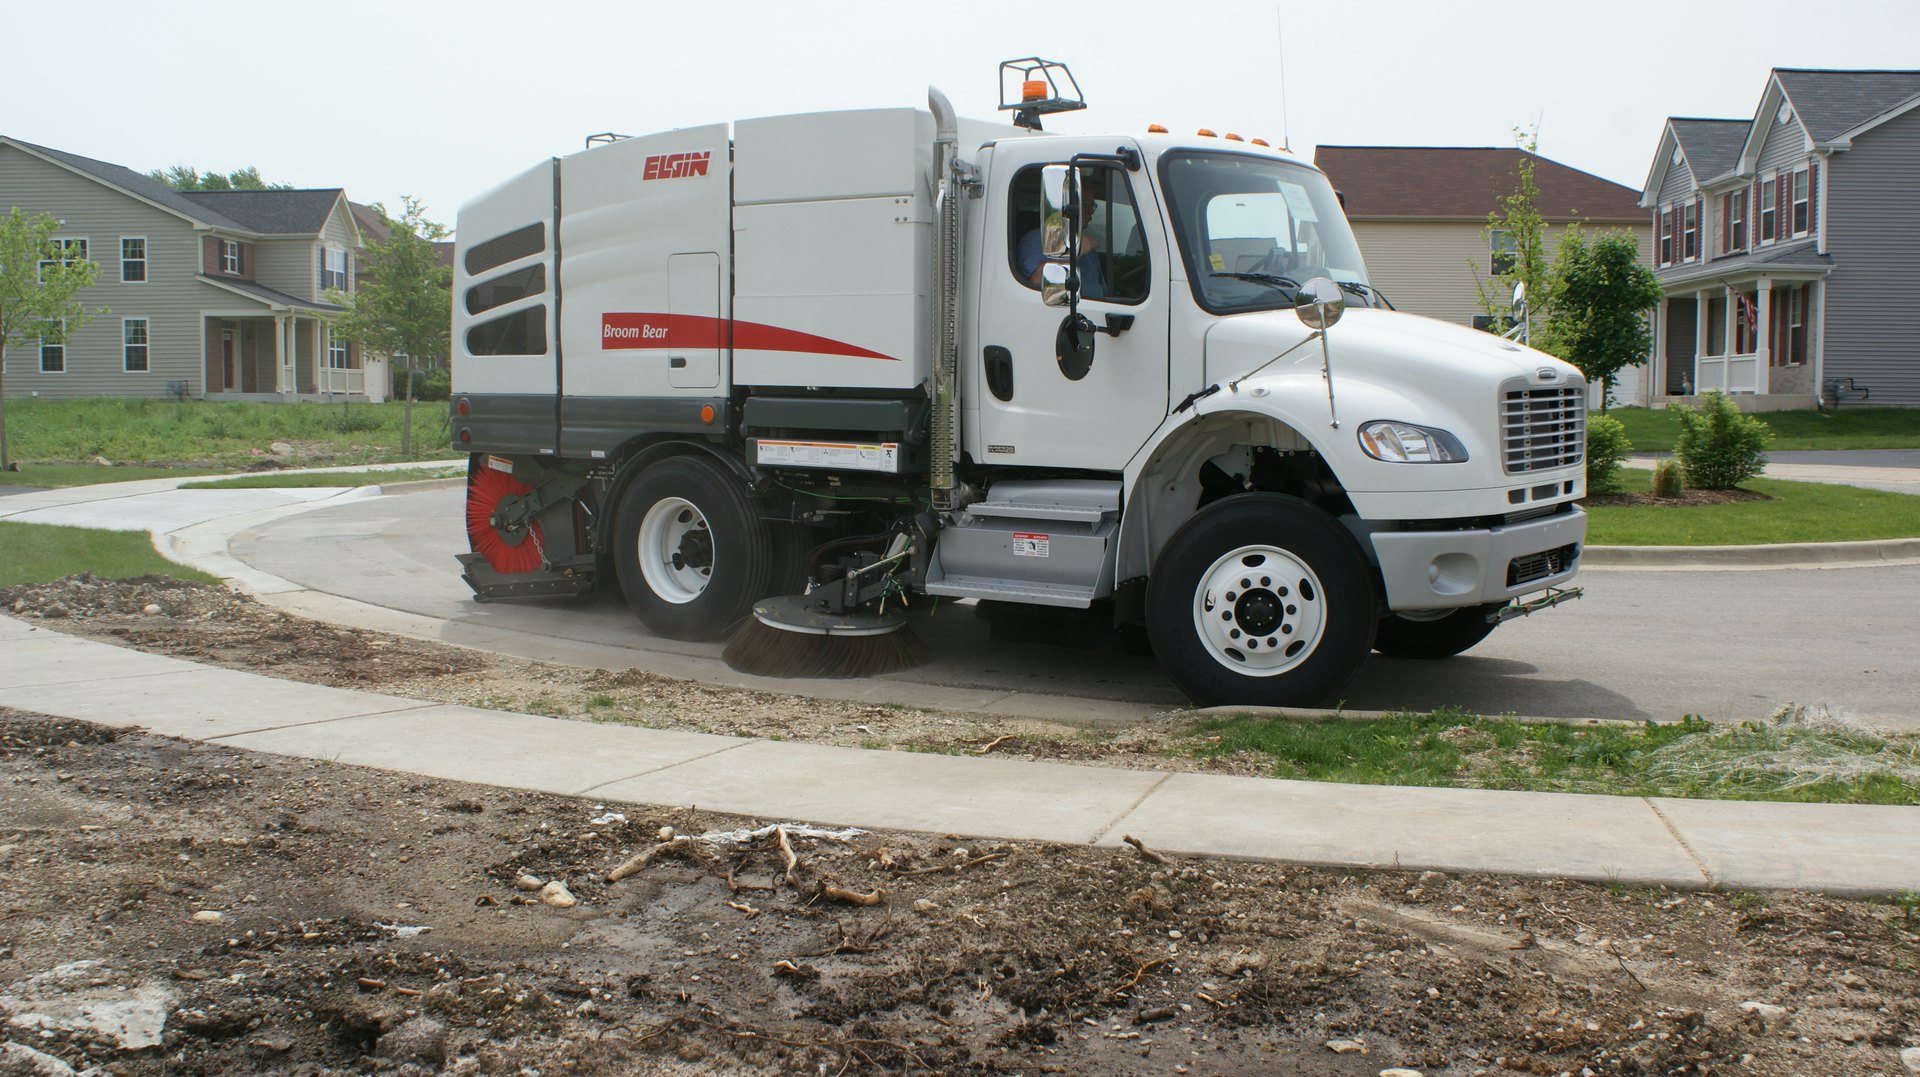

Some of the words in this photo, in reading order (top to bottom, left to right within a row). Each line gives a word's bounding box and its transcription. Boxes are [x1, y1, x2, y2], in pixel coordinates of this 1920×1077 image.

[643, 151, 711, 181] ELGIN
[603, 324, 639, 338] Broom
[642, 324, 669, 339] Bear
